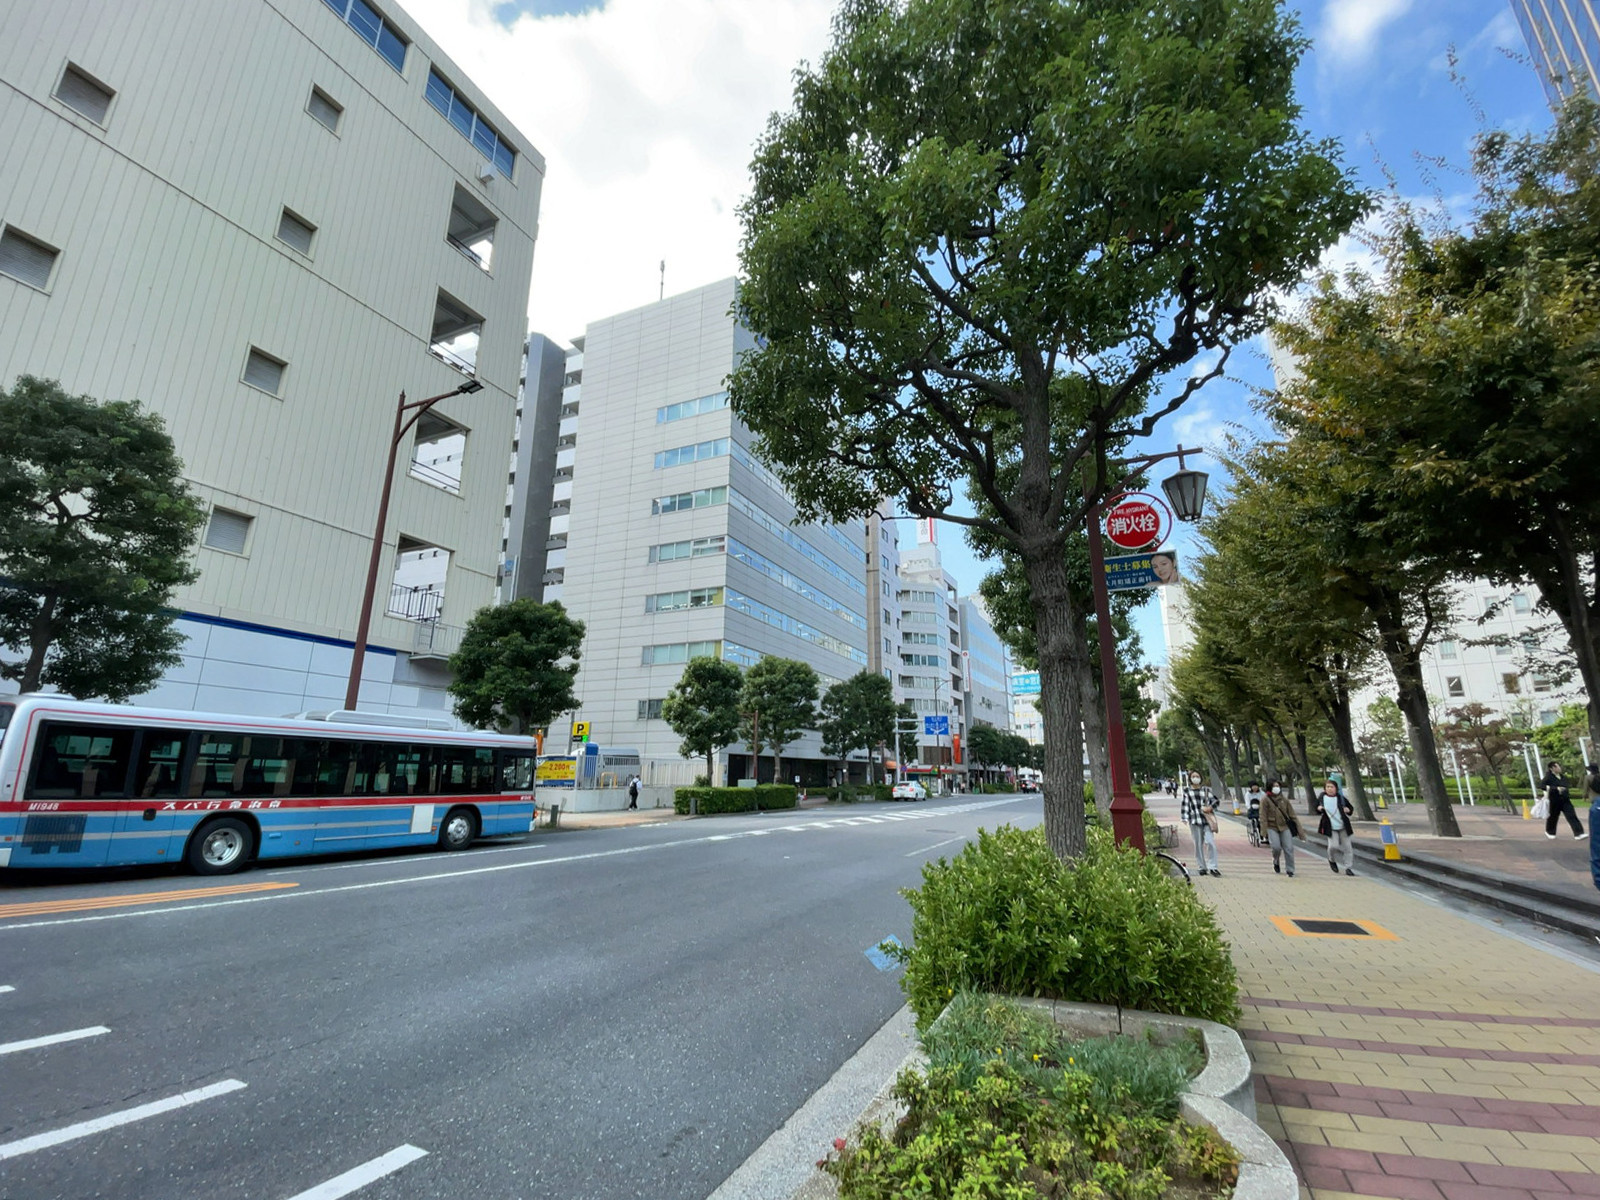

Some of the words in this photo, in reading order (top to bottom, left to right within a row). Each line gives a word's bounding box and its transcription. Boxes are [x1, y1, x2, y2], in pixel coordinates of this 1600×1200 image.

[1111, 513, 1156, 535] 消火栓
[576, 724, 584, 734] P
[28, 802, 59, 811] M1948
